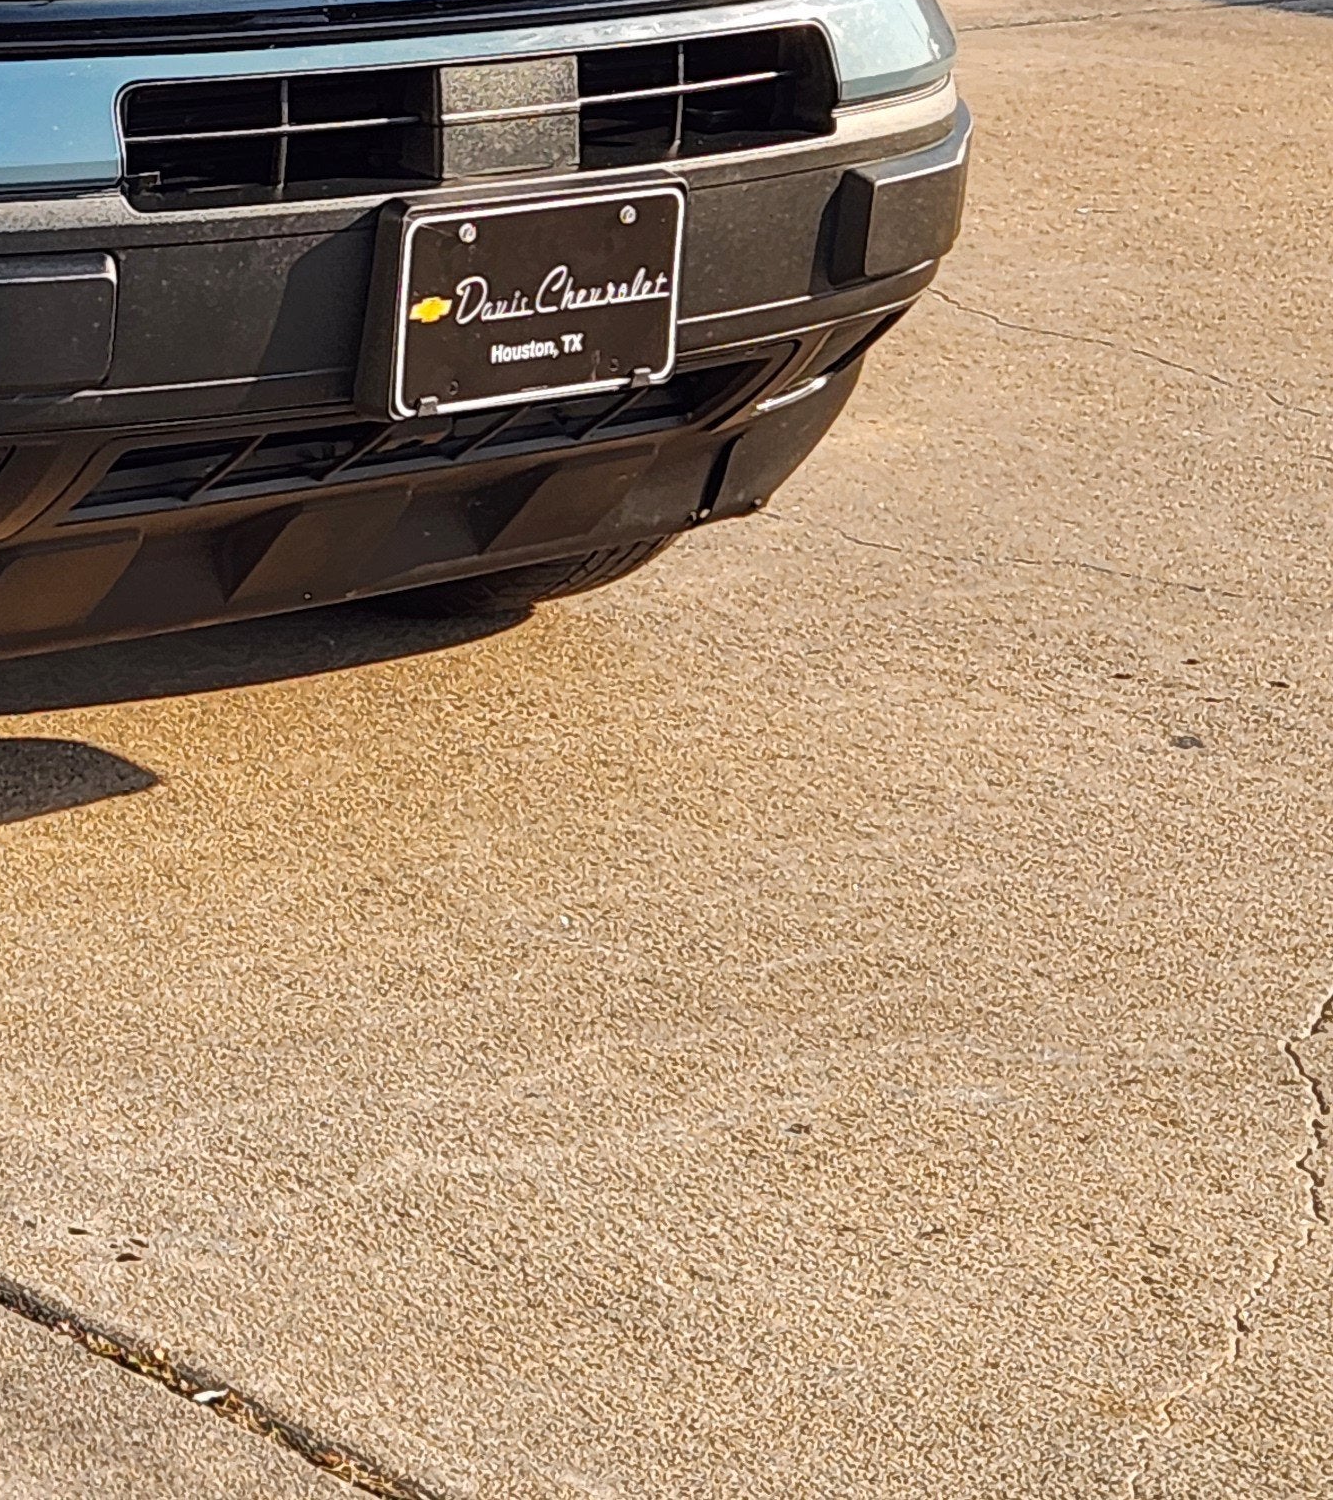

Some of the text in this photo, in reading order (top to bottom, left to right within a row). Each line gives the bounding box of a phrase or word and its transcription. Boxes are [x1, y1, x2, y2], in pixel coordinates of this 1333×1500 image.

[455, 265, 671, 325] Davis Chevrolet
[491, 333, 584, 364] Houston, TX
